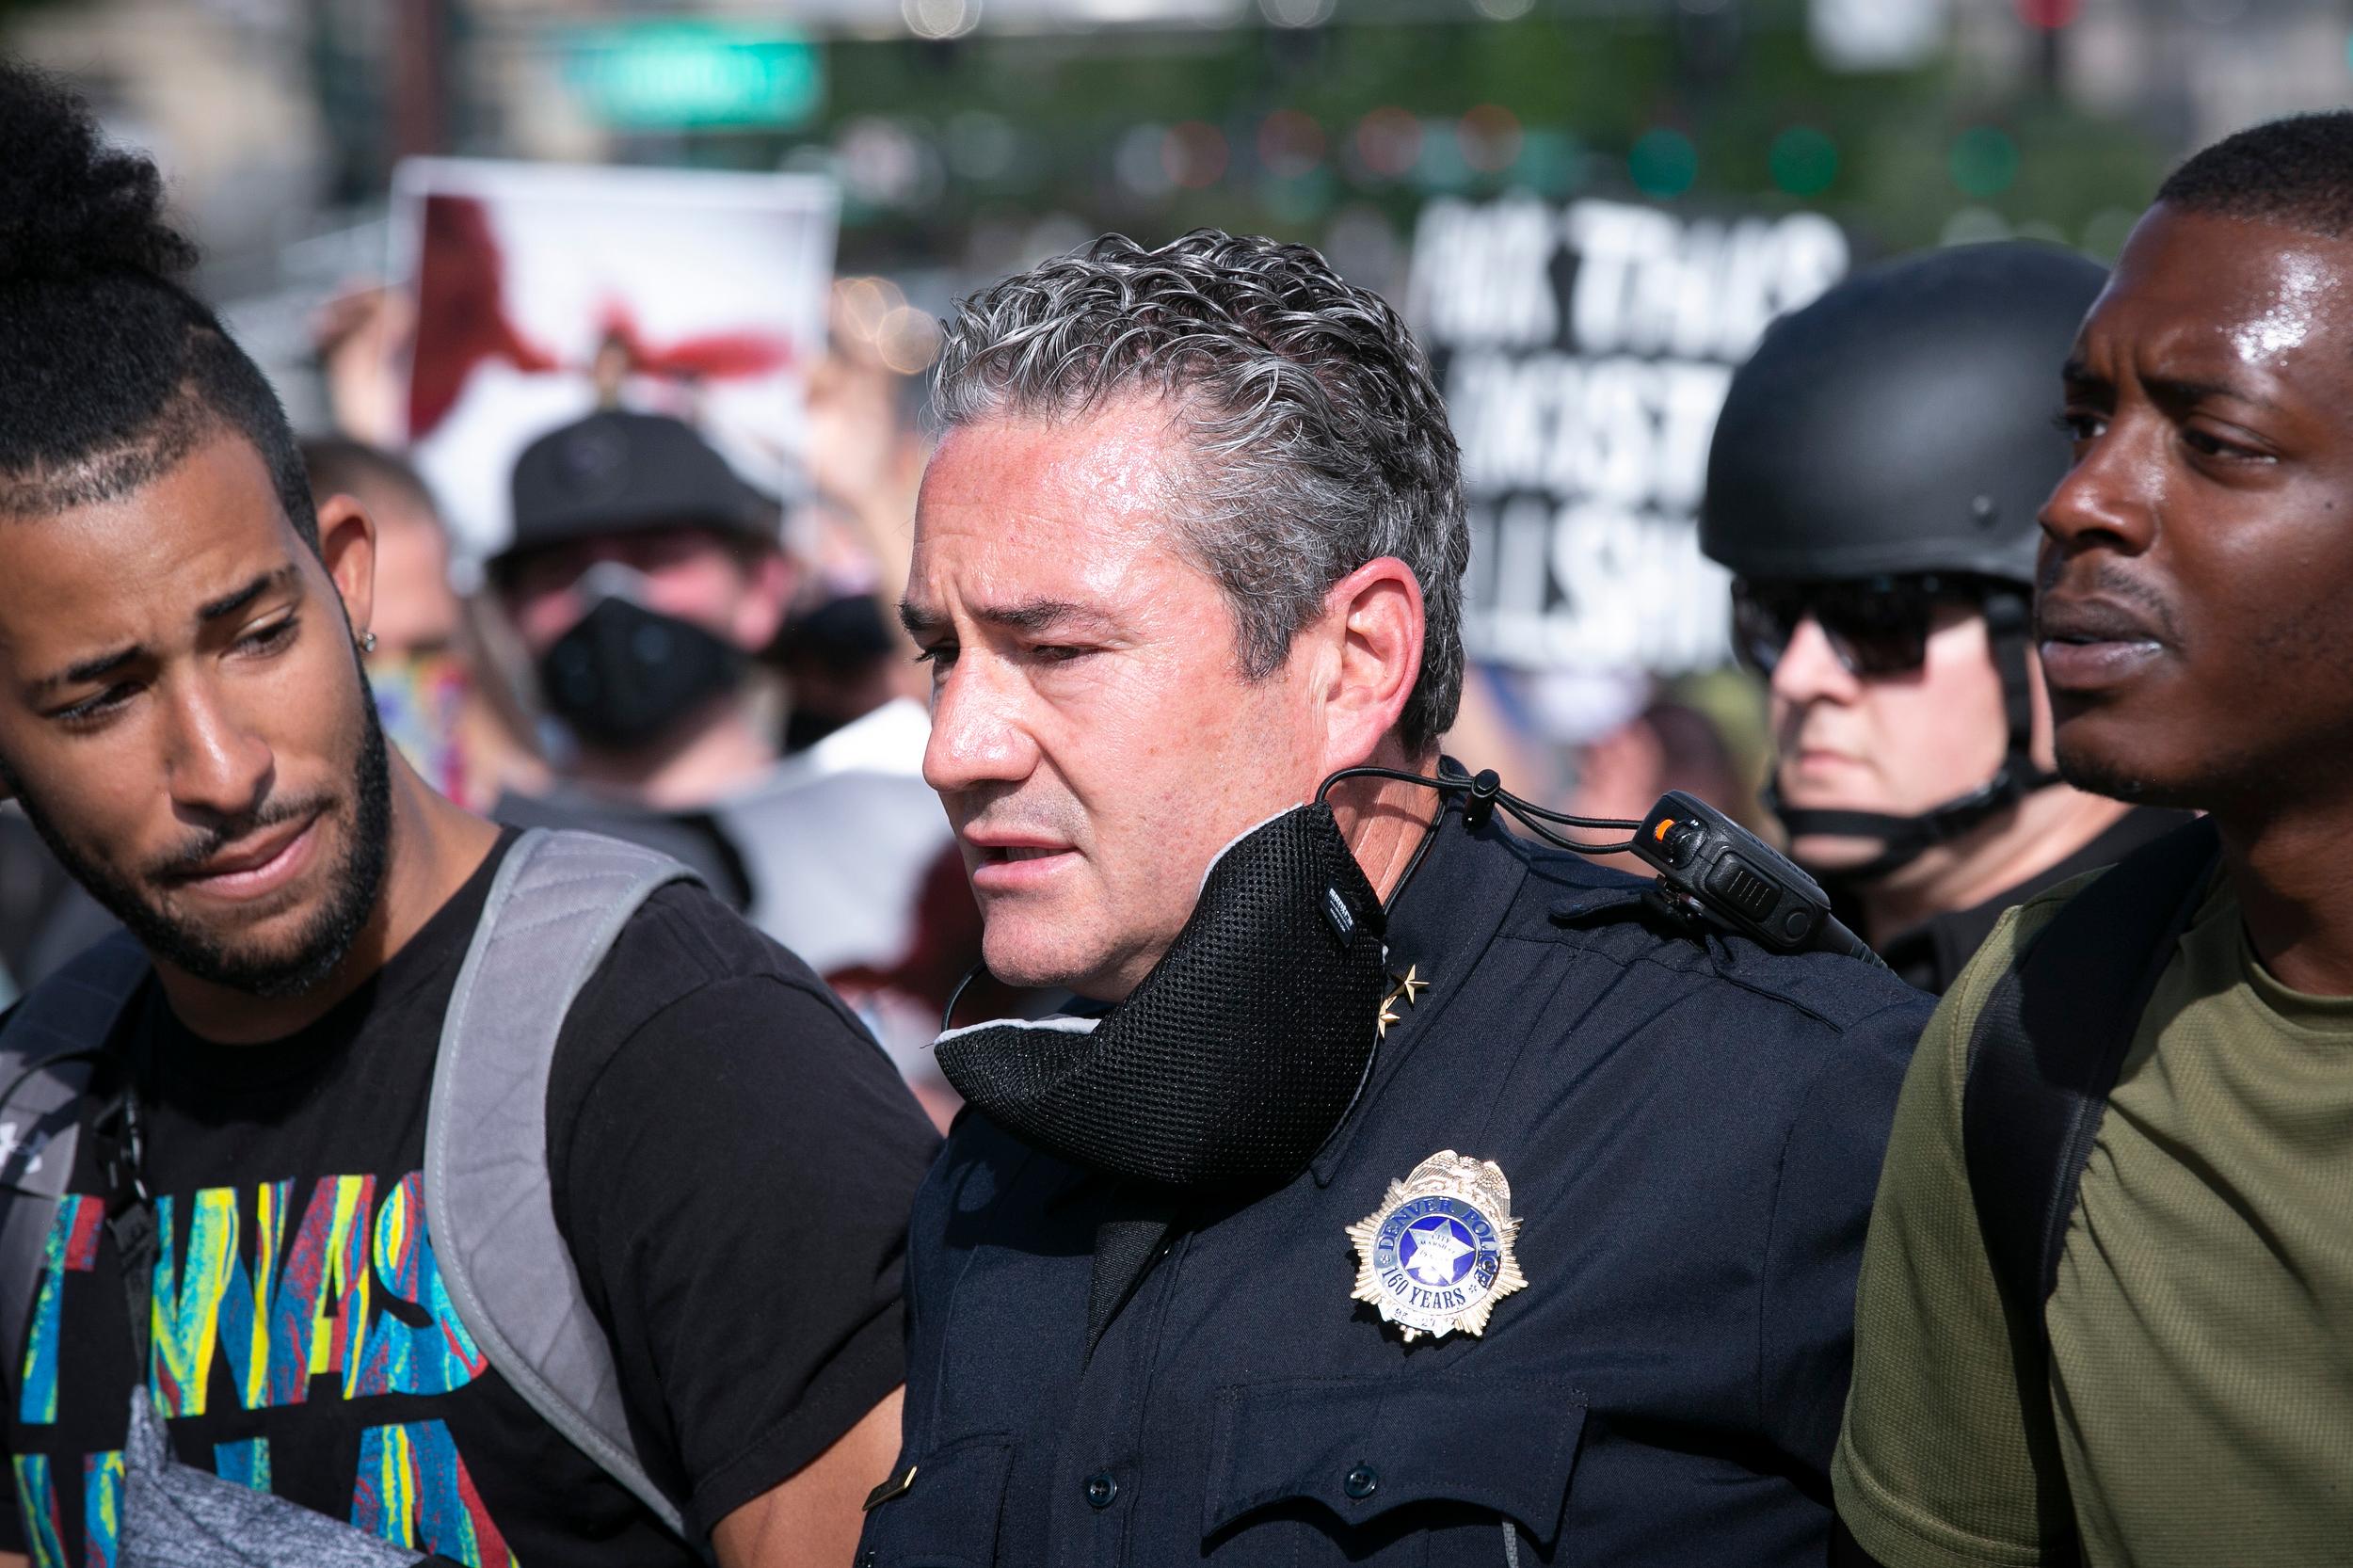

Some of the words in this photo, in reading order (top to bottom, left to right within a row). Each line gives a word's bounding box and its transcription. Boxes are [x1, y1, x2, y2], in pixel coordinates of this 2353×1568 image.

[1378, 1197, 1453, 1251] DENVER
[1461, 1208, 1499, 1289] POLICE
[1382, 1266, 1409, 1296] 160
[1408, 1287, 1466, 1310] YEARS
[148, 1170, 488, 1418] WAS
